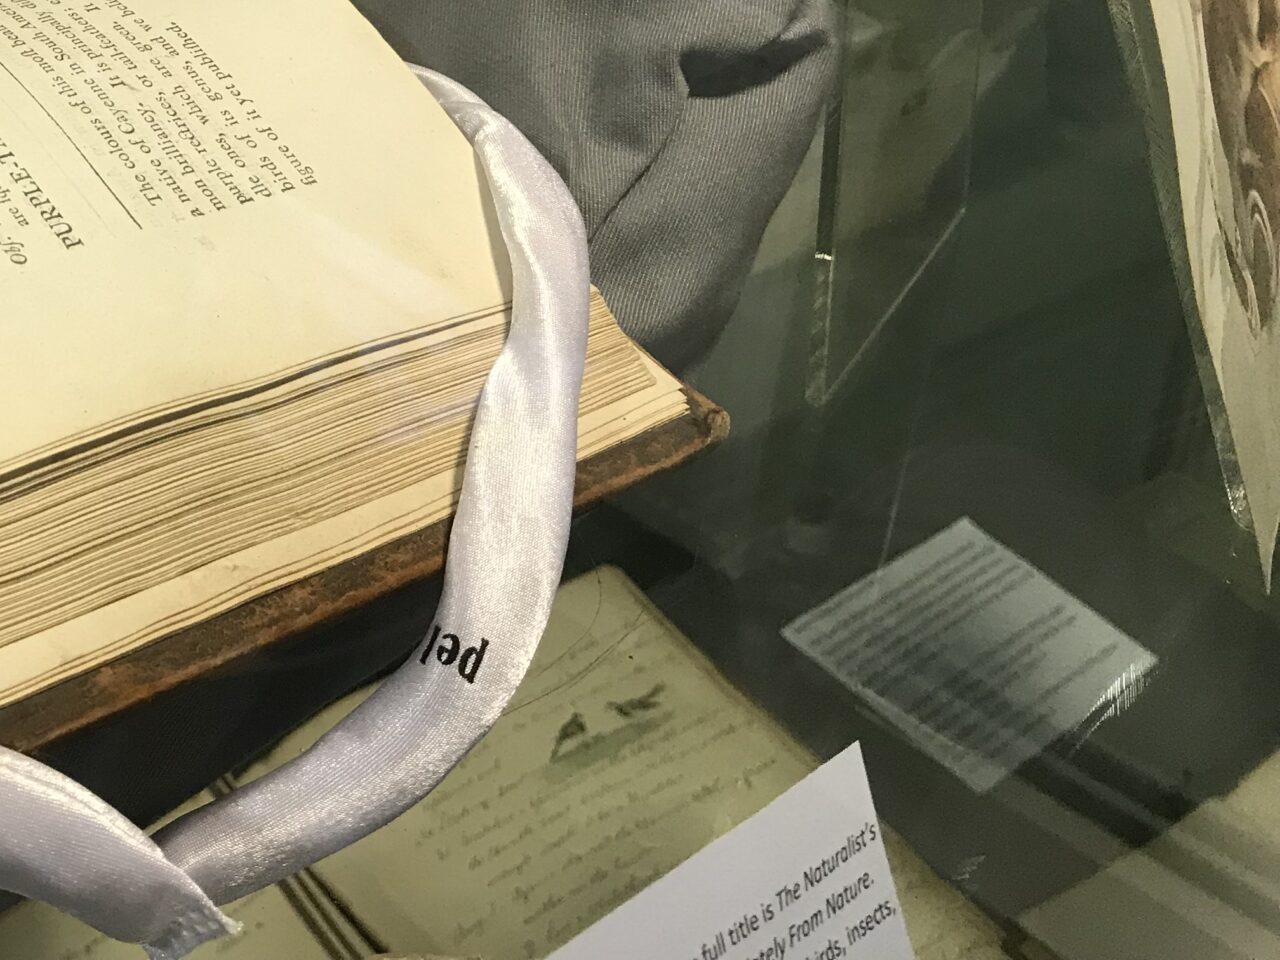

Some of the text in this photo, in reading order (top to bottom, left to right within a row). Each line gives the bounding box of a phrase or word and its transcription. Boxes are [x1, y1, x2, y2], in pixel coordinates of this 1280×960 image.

[83, 1, 101, 13] It
[34, 10, 103, 59] principally
[63, 6, 138, 70] tail-feathers;
[111, 20, 153, 53] green.
[132, 17, 153, 32] we
[31, 30, 71, 62] South
[148, 34, 180, 57] and
[68, 61, 86, 76] in
[95, 61, 113, 73] is
[107, 74, 129, 89] It
[134, 73, 154, 88] or
[148, 56, 173, 78] are
[181, 59, 223, 102] genus,
[51, 74, 78, 98] this
[224, 82, 254, 106] yet
[67, 99, 92, 115] of
[82, 77, 136, 135] Cayenne
[171, 83, 209, 125] which
[219, 108, 240, 127] its
[245, 108, 262, 121] it
[154, 90, 208, 154] rectrices,
[254, 125, 279, 141] of
[89, 117, 136, 169] colours
[127, 138, 152, 154] of
[136, 101, 195, 176] brilliancy.
[214, 131, 246, 168] ones,
[232, 133, 258, 149] of
[149, 157, 191, 203] native
[205, 157, 255, 205] purple
[258, 155, 296, 192] birds
[277, 144, 318, 186] figure
[133, 173, 163, 206] The
[193, 177, 227, 212] mon
[247, 174, 273, 198] dle
[7, 205, 30, 227] are
[701, 932, 728, 960] full
[728, 913, 760, 947] title
[760, 902, 775, 923] is
[774, 881, 801, 912] The
[746, 871, 875, 960] tely From Nature.
[844, 899, 897, 946] insects,
